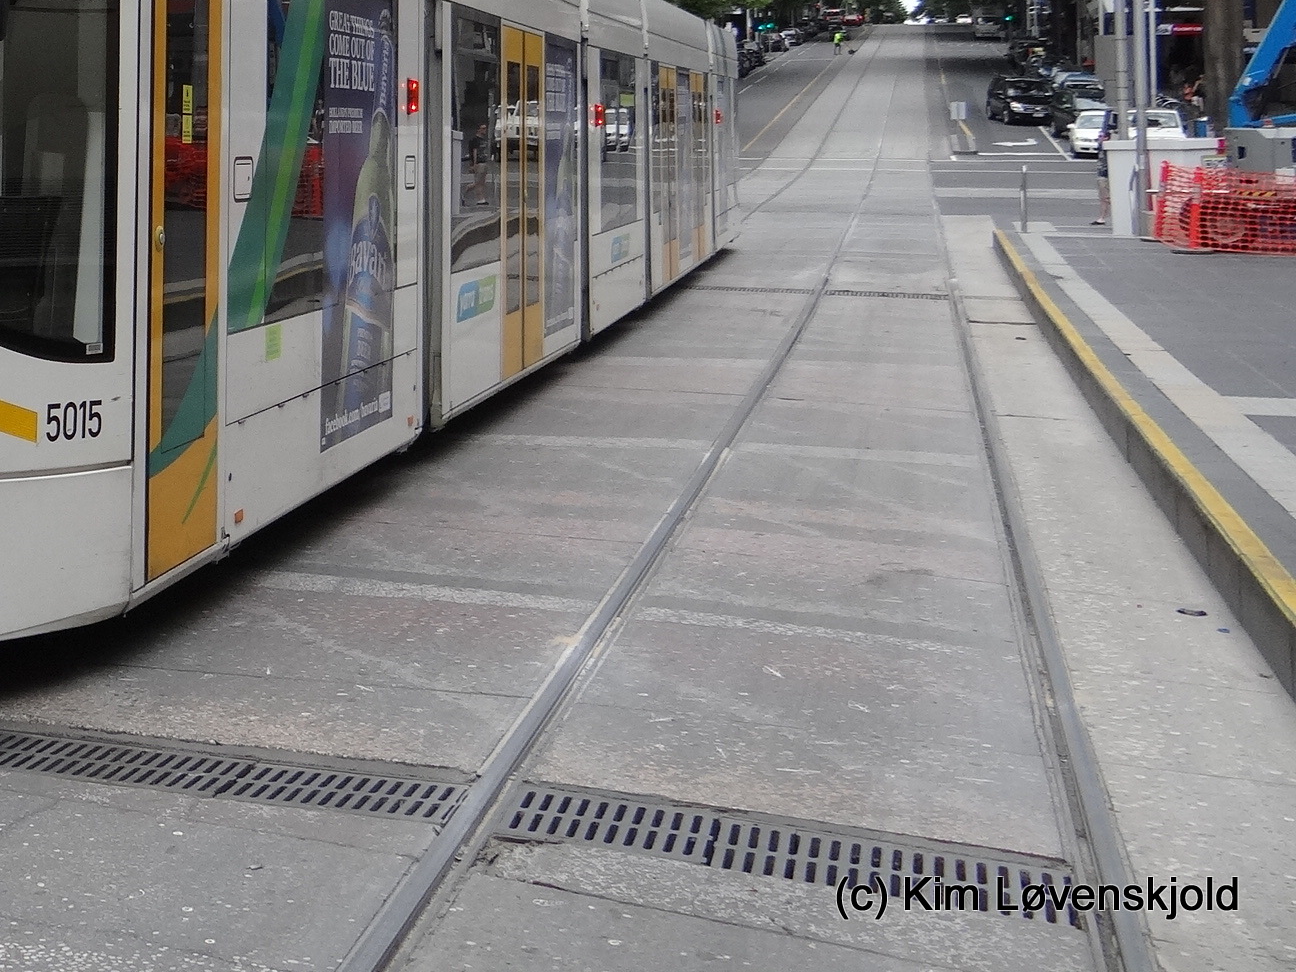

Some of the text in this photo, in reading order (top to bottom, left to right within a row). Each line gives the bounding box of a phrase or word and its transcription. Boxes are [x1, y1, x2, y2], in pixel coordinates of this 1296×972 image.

[329, 10, 375, 39] GREAT THINGS
[329, 33, 375, 61] COME OUT OF
[329, 57, 375, 92] THE BLUE
[45, 399, 103, 443] 5015
